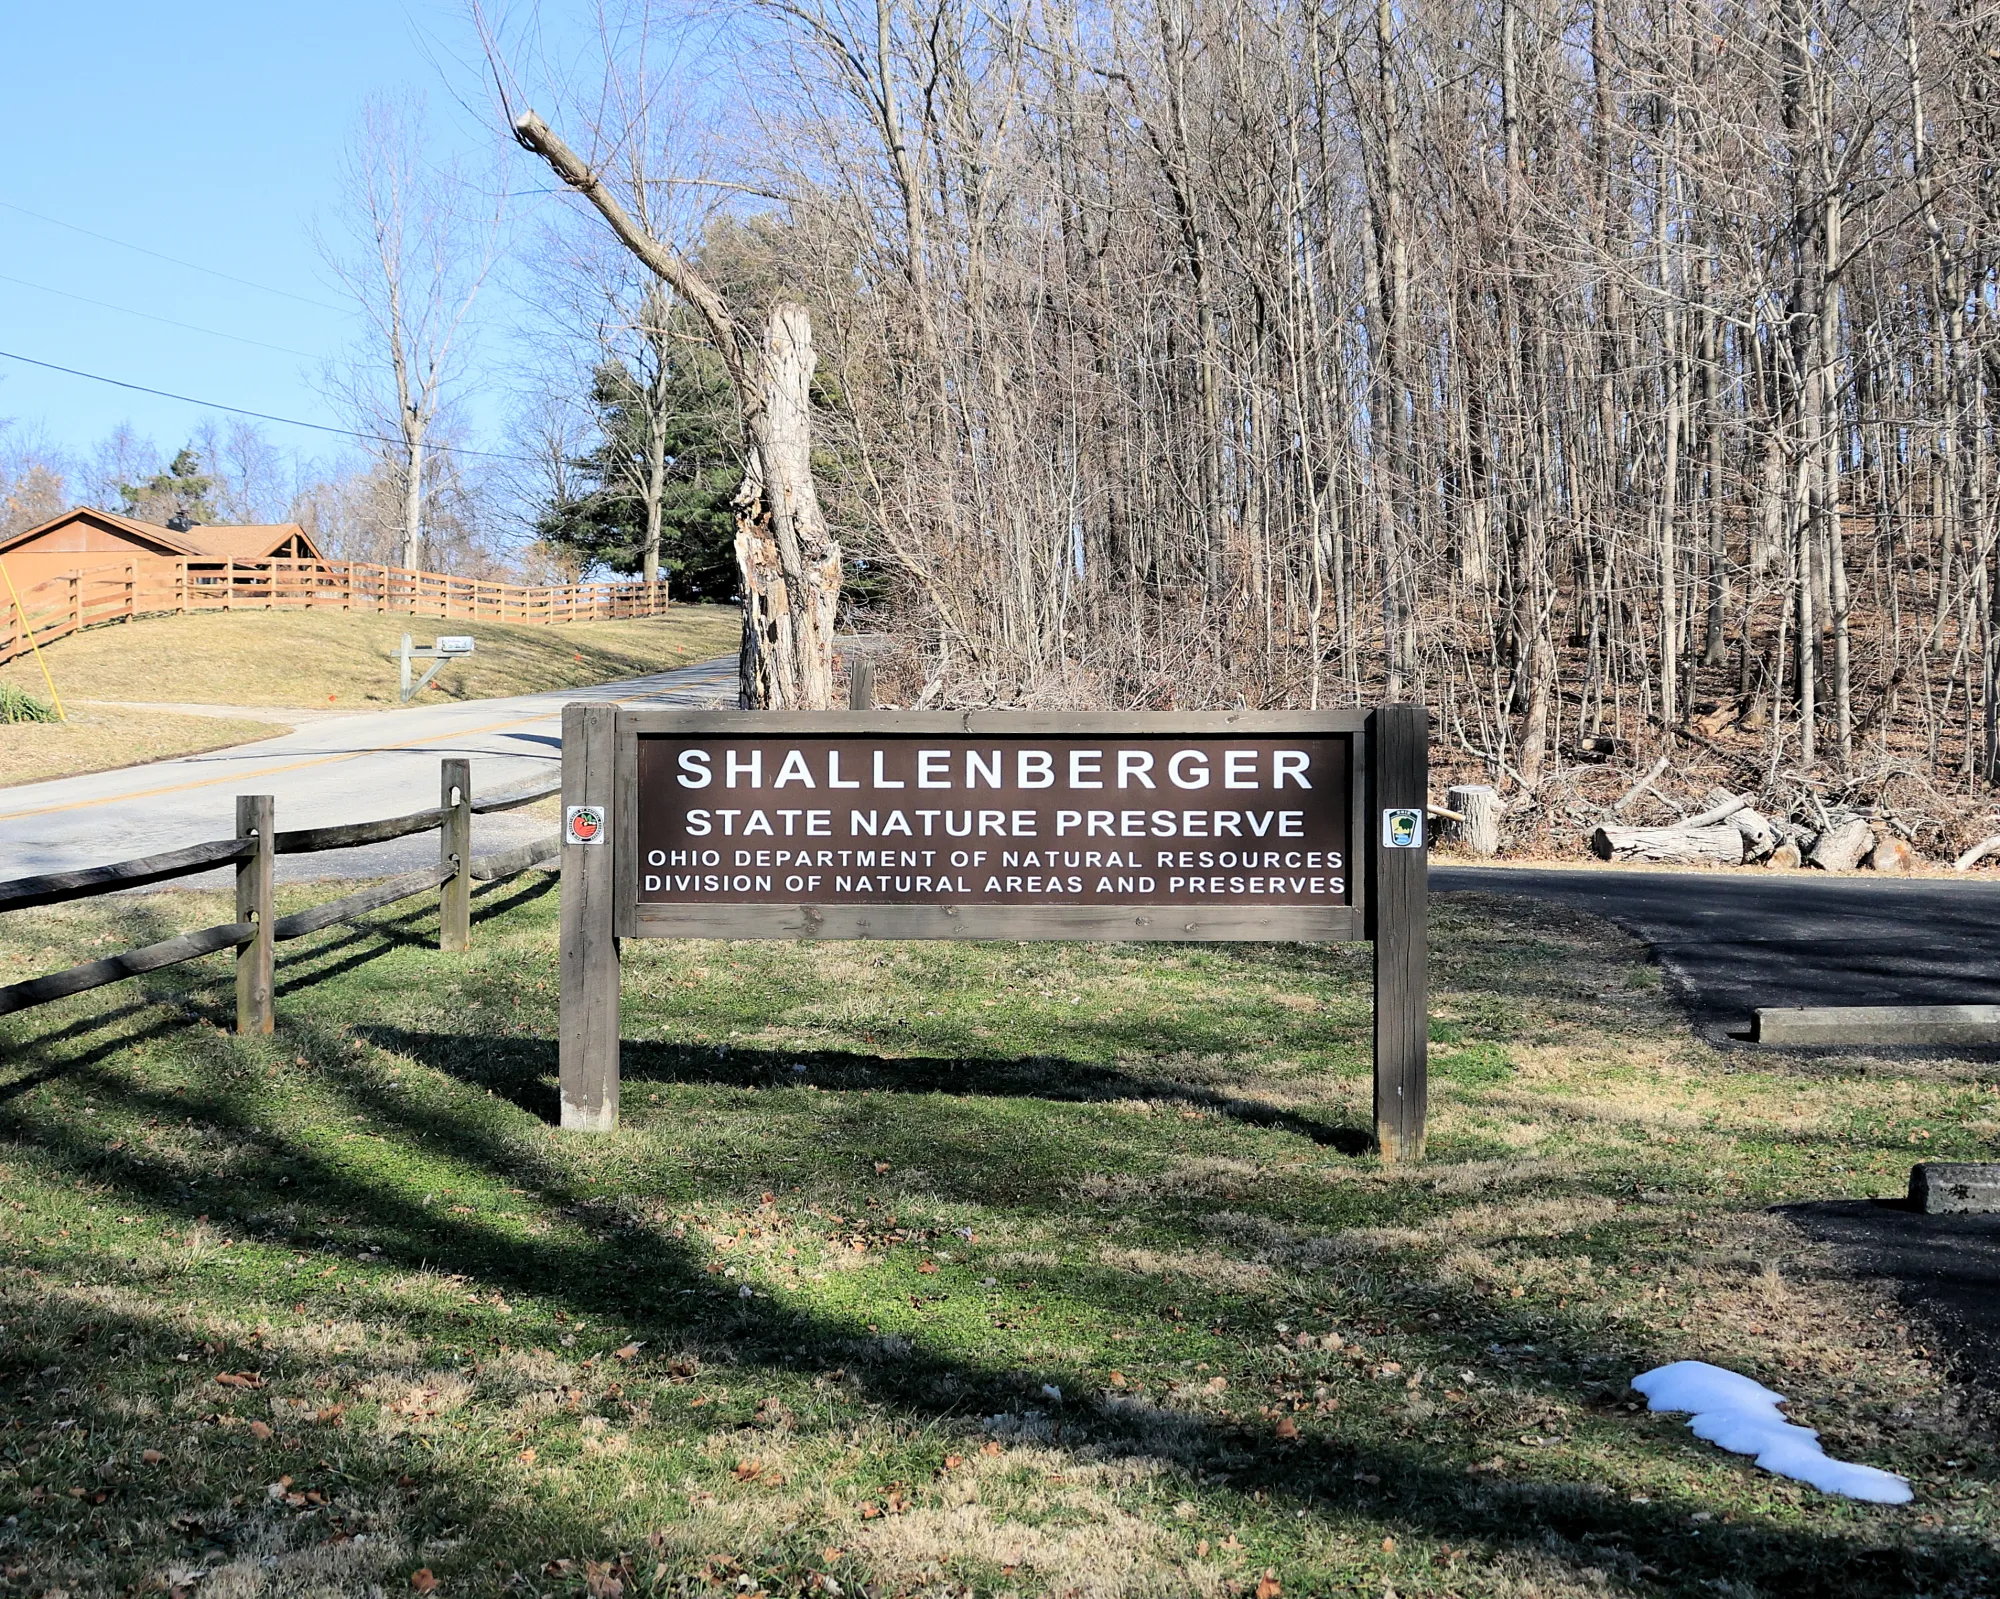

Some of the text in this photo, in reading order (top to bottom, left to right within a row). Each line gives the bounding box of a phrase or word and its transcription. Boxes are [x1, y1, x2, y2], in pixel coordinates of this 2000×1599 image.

[677, 750, 1312, 788] SHALLENBERGER
[685, 809, 1304, 836] STATE NATURE PRESERVE
[647, 850, 1342, 867] OHIO DEPARTMENT OF NATURAL RESOURCES
[645, 875, 1344, 893] DIVISION OF NATURAL AREAS AND PRESERVES
